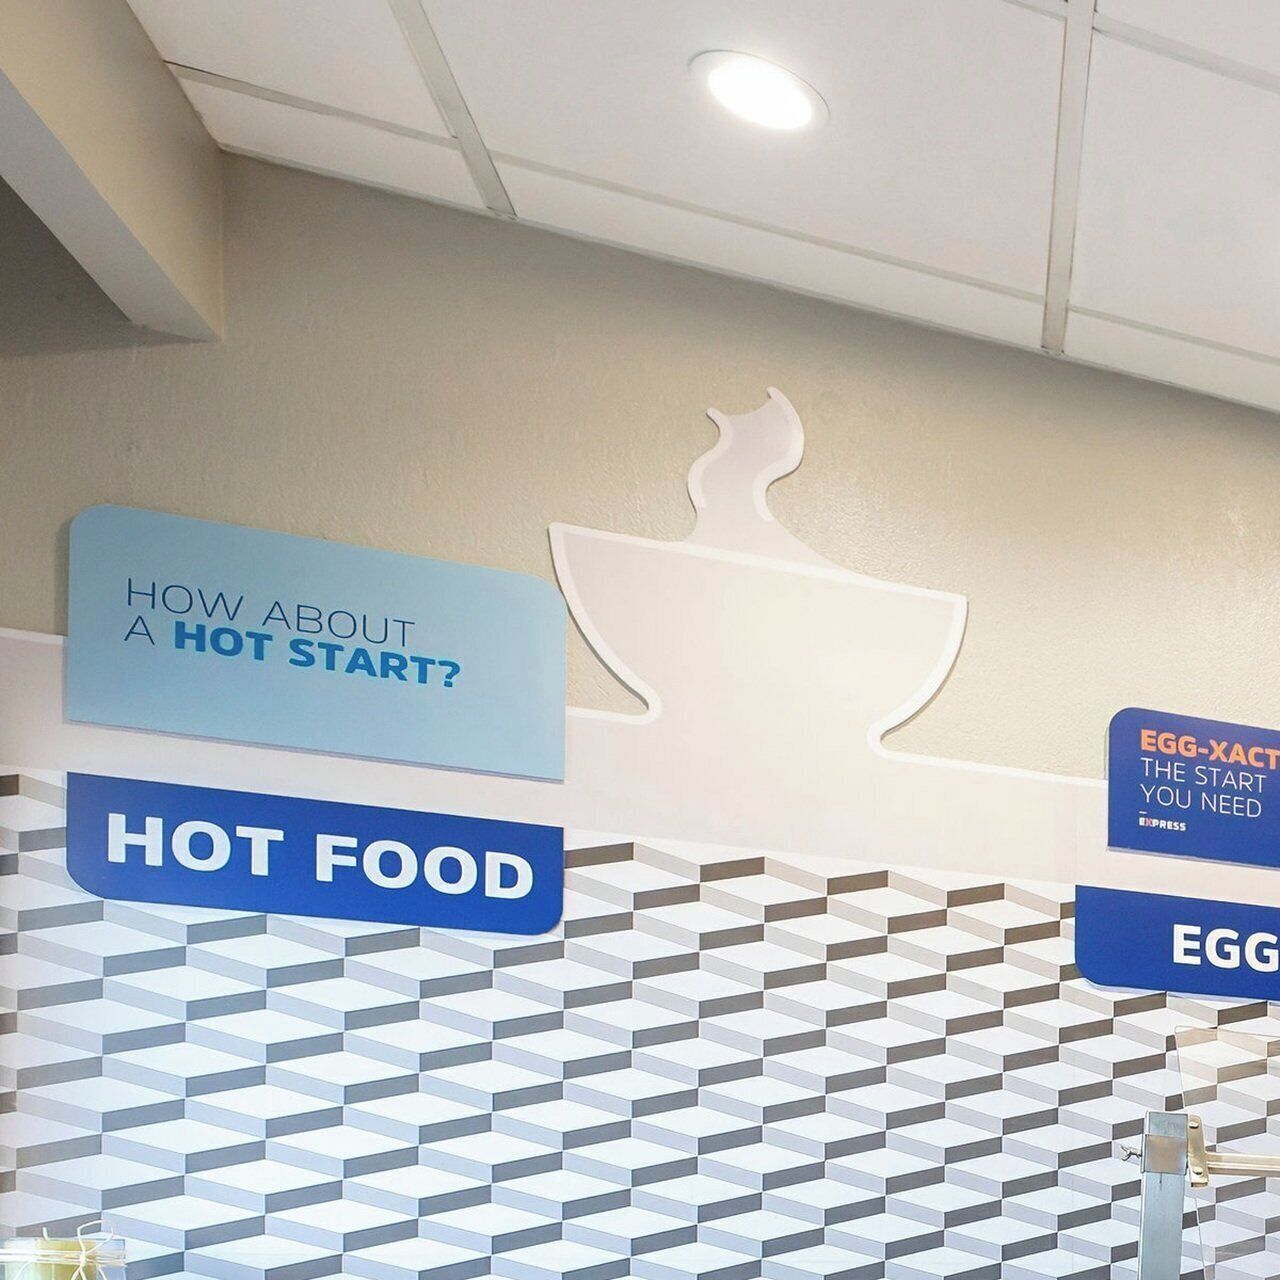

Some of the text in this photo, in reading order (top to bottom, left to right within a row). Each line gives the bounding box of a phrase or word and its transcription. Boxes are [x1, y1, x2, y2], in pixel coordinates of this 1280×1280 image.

[127, 577, 416, 648] HOW ABOUT
[123, 615, 461, 688] A HOT START?
[1139, 783, 1263, 818] YOU NEED
[1140, 756, 1268, 793] THE START
[1138, 816, 1187, 832] EXPRESS
[106, 812, 534, 900] HOT FOOD
